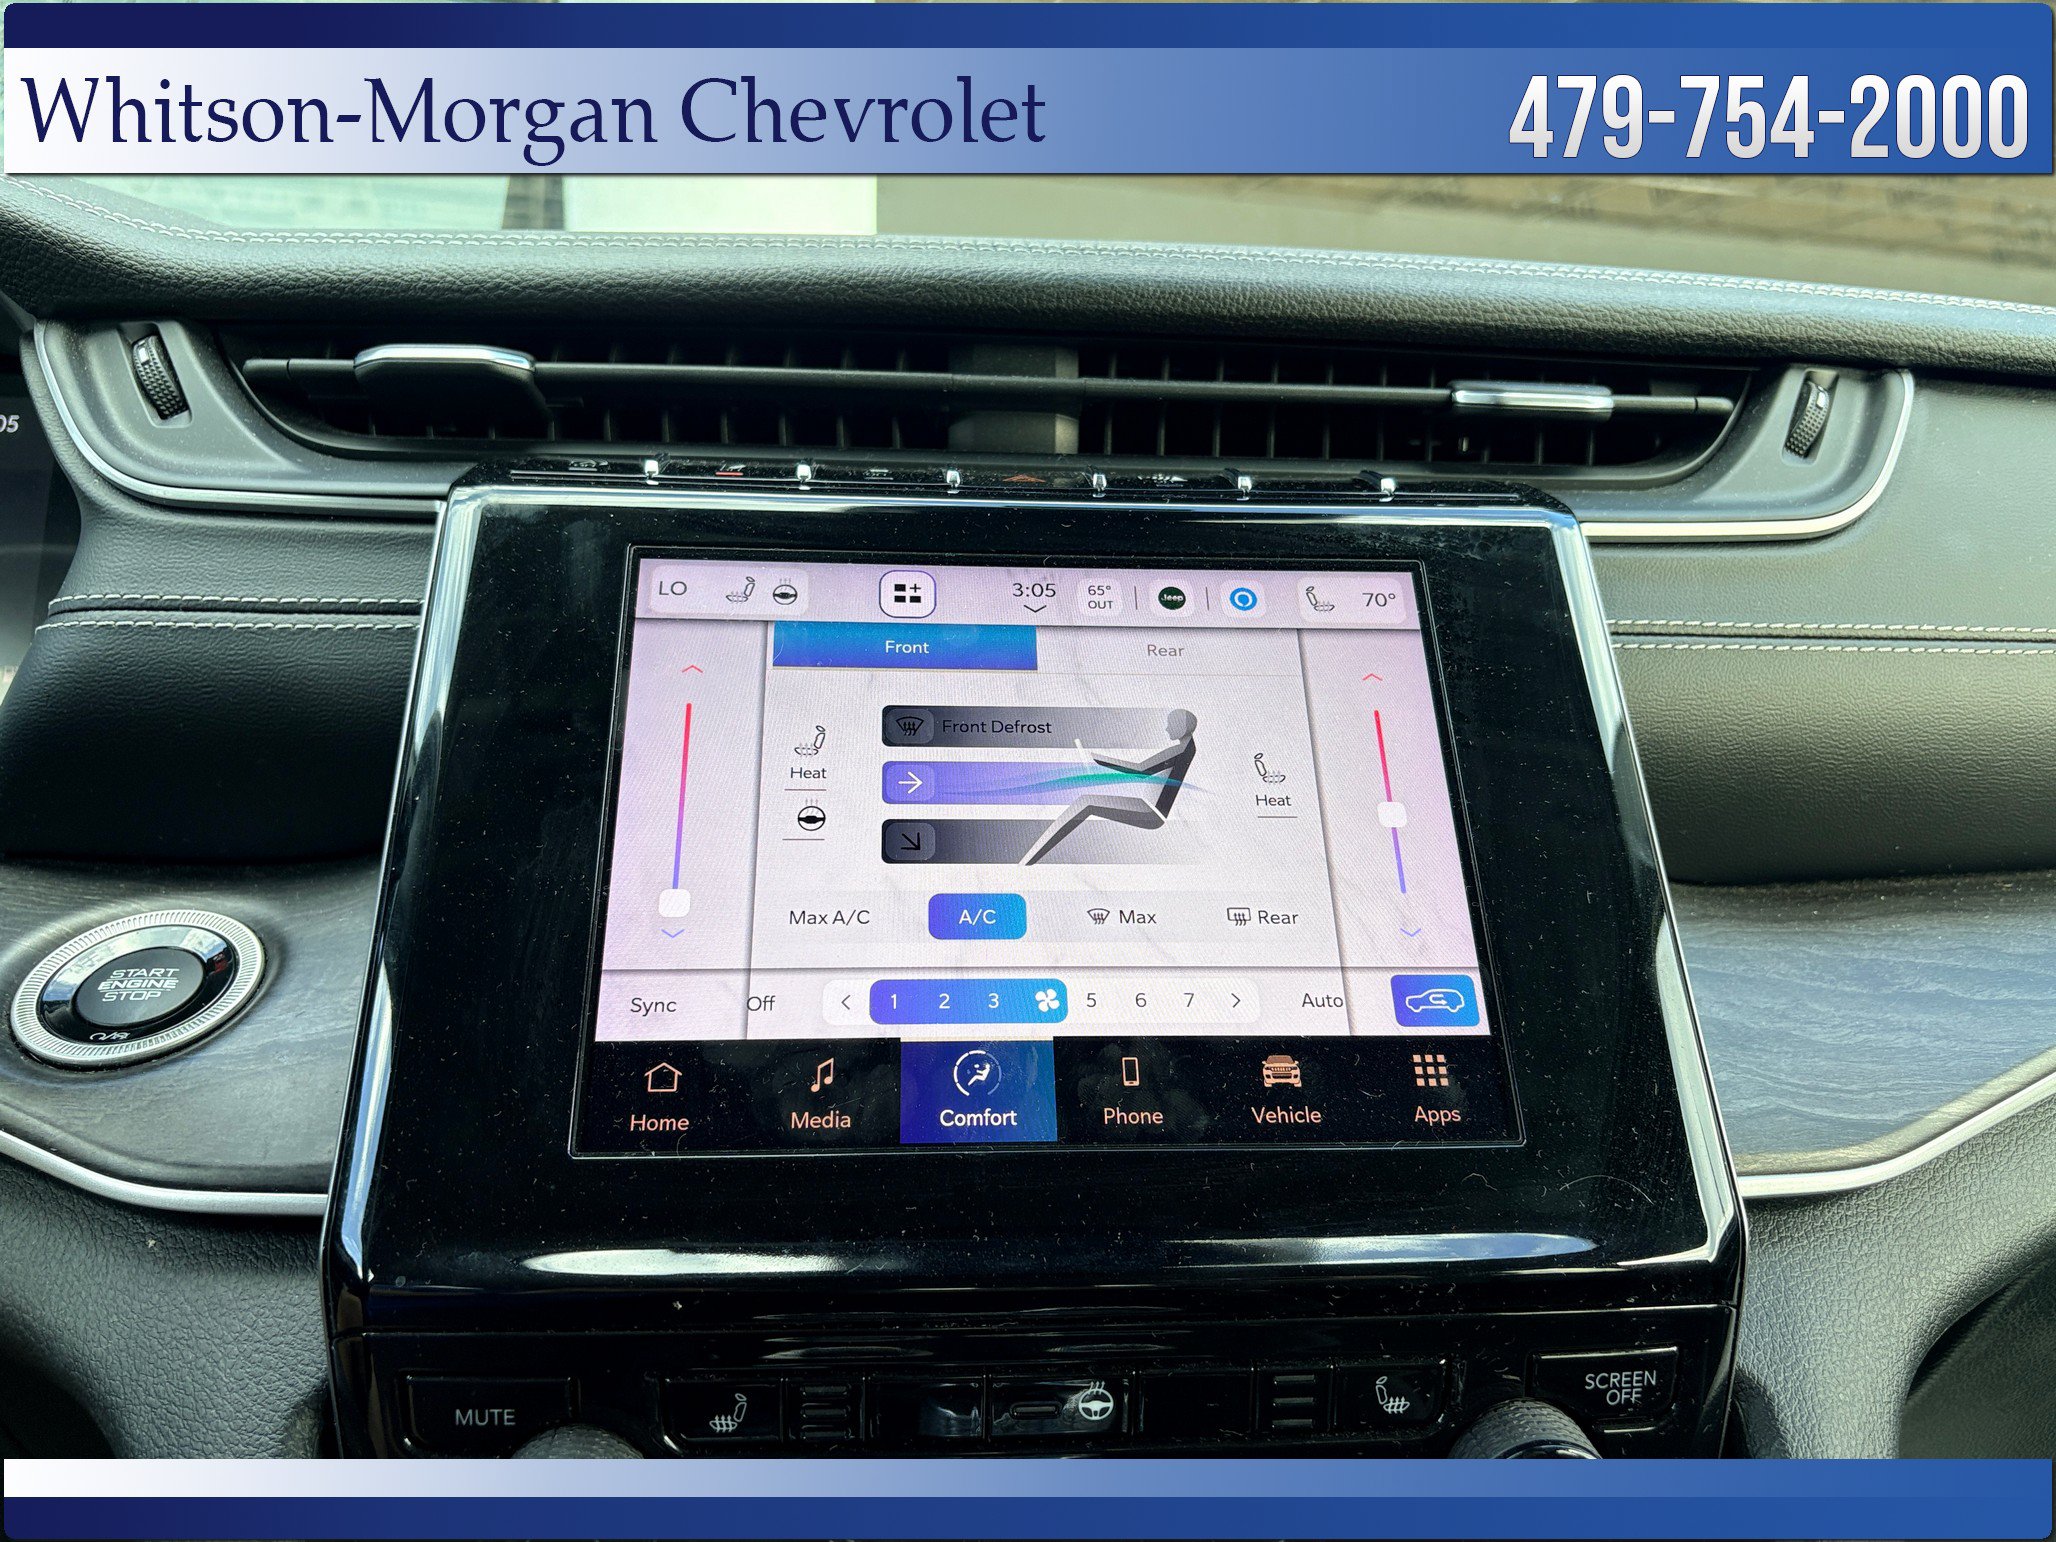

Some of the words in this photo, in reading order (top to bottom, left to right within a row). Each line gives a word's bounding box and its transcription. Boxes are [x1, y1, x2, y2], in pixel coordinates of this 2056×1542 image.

[658, 580, 688, 597] LO
[1011, 582, 1057, 599] 3:05
[1088, 584, 1112, 597] 65°
[1087, 599, 1114, 610] OUT
[1161, 594, 1185, 603] Jeep
[1362, 592, 1397, 608] 70°
[884, 639, 930, 655] Front
[1147, 643, 1185, 658] Rear
[942, 719, 987, 734] Front
[991, 719, 1053, 734] Defrost
[789, 766, 827, 780] Heat
[1255, 793, 1292, 808] Heat
[789, 910, 829, 926] Max
[832, 908, 871, 927] A/C
[958, 908, 997, 926] A/C
[1118, 909, 1158, 925] Max
[1258, 909, 1299, 925] Rear
[110, 968, 180, 978] START
[98, 979, 179, 990] ENGINE
[103, 991, 161, 1002] STOP
[746, 995, 776, 1013] Off
[889, 994, 898, 1009] 1
[938, 994, 951, 1010] 2
[987, 993, 1000, 1009] 3
[1086, 993, 1097, 1008] 5
[1134, 993, 1147, 1008] 6
[1183, 993, 1195, 1008] 7
[1301, 993, 1344, 1009] Auto
[630, 996, 678, 1018] Sync
[630, 1114, 689, 1132] Home
[791, 1111, 851, 1129] Media
[939, 1108, 1018, 1128] Comfort
[1103, 1107, 1164, 1125] Phone
[1251, 1106, 1322, 1125] Vehicle
[1414, 1106, 1462, 1127] Apps
[1584, 1370, 1658, 1390] SCREEN
[1605, 1388, 1643, 1406] OFF
[455, 1408, 517, 1426] MUTE
